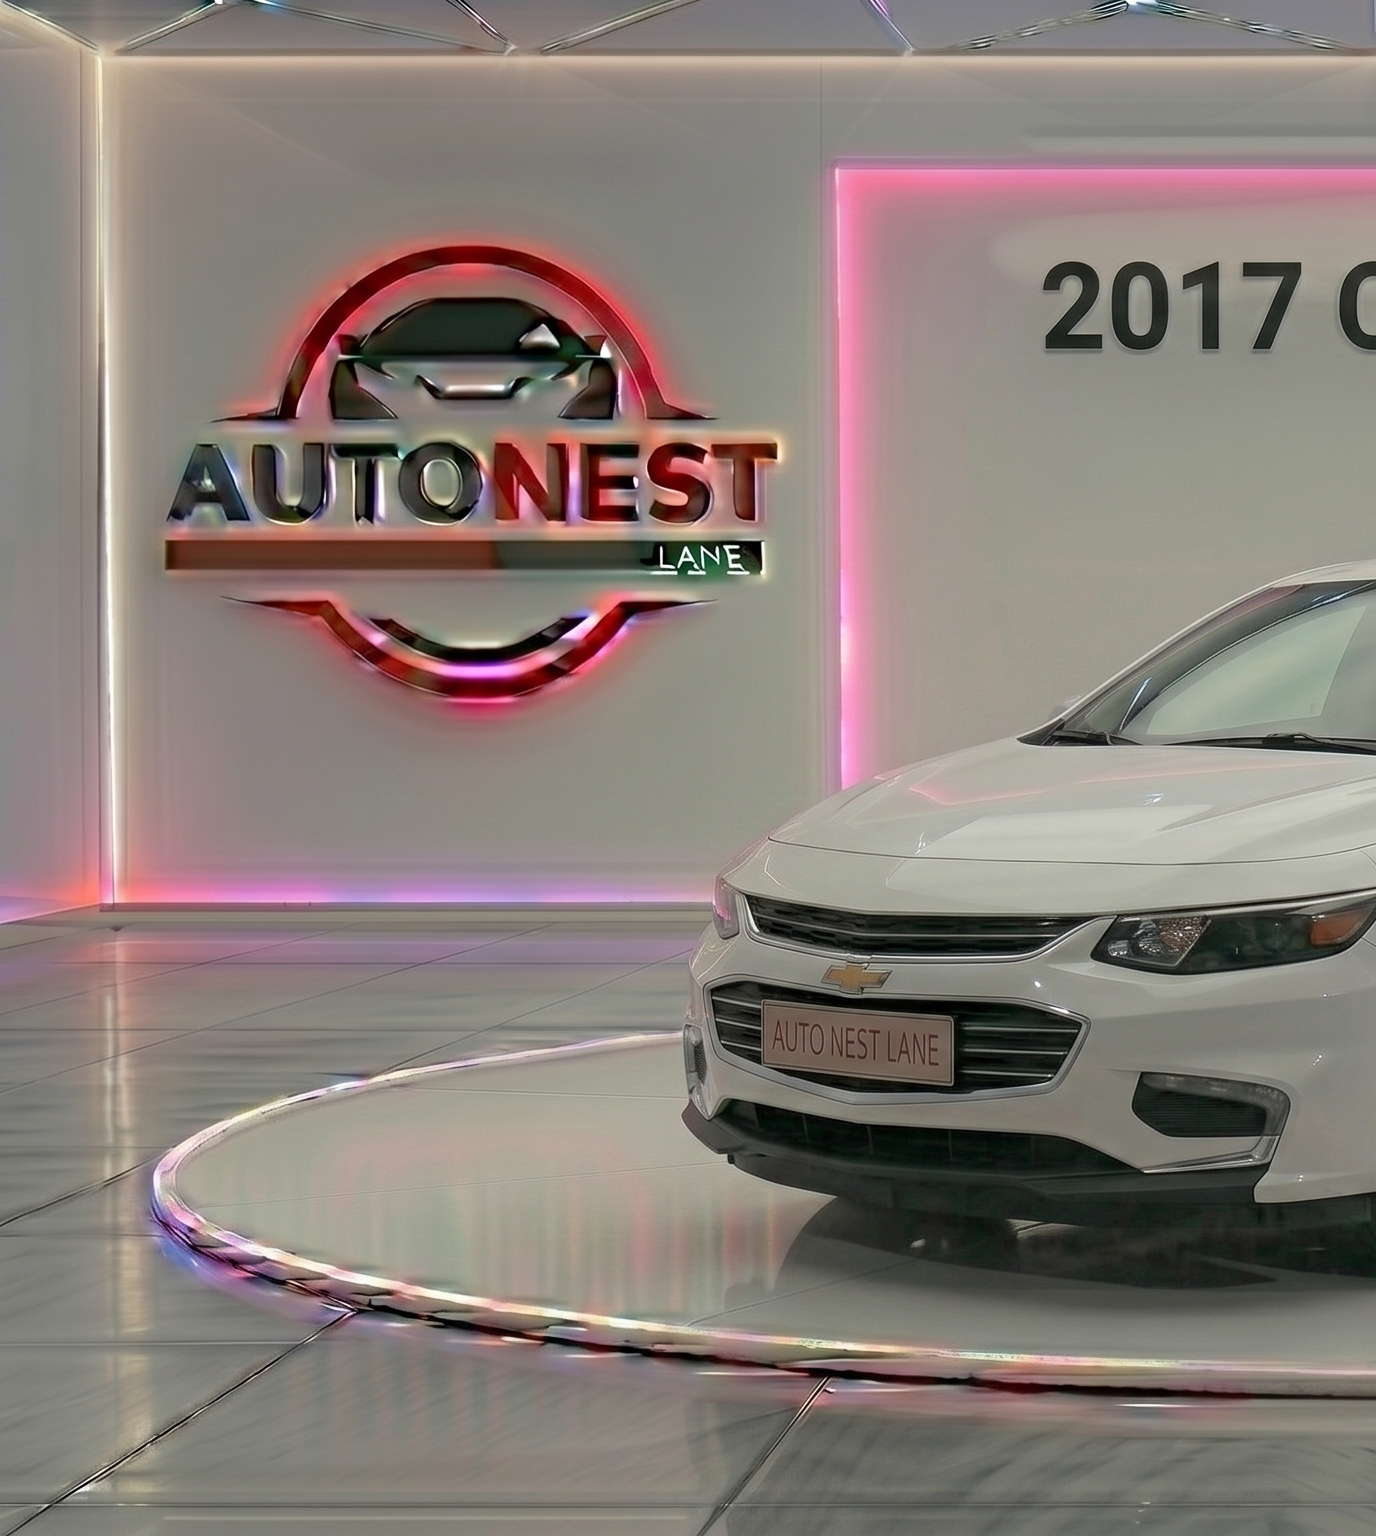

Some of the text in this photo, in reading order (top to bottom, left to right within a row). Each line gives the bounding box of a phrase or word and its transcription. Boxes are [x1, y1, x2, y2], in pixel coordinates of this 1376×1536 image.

[1042, 261, 1303, 350] 2017
[166, 441, 779, 525] AUTONEST
[659, 544, 745, 572] LANE
[772, 1019, 939, 1066] AUTO NEST LANE
